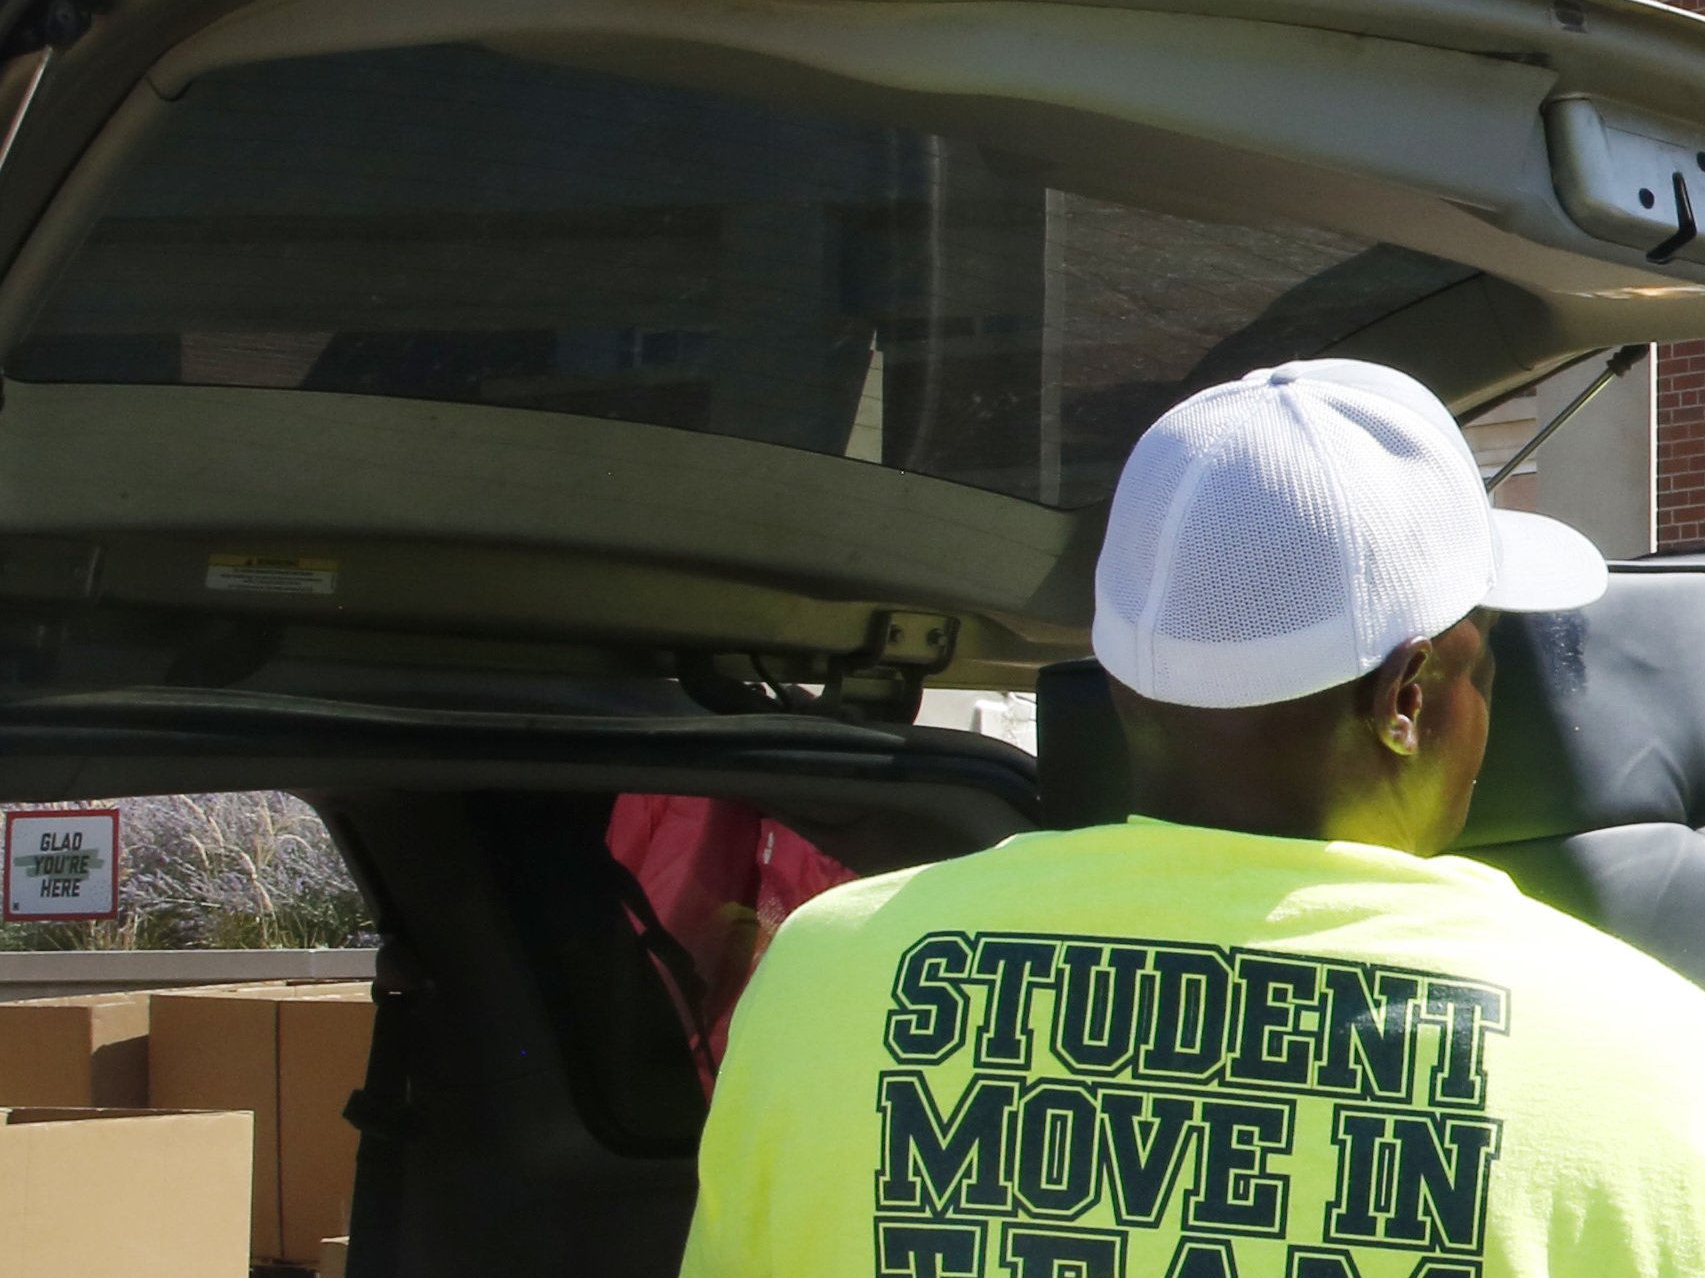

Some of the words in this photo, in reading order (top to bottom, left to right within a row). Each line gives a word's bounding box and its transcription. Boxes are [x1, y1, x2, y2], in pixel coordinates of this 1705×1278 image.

[39, 831, 83, 852] GLAD
[33, 854, 90, 875] YOU'RE
[40, 878, 81, 898] HERE
[884, 930, 1511, 1111] STUDENT
[875, 1070, 1297, 1239] MOVE
[1322, 1102, 1503, 1258] IN
